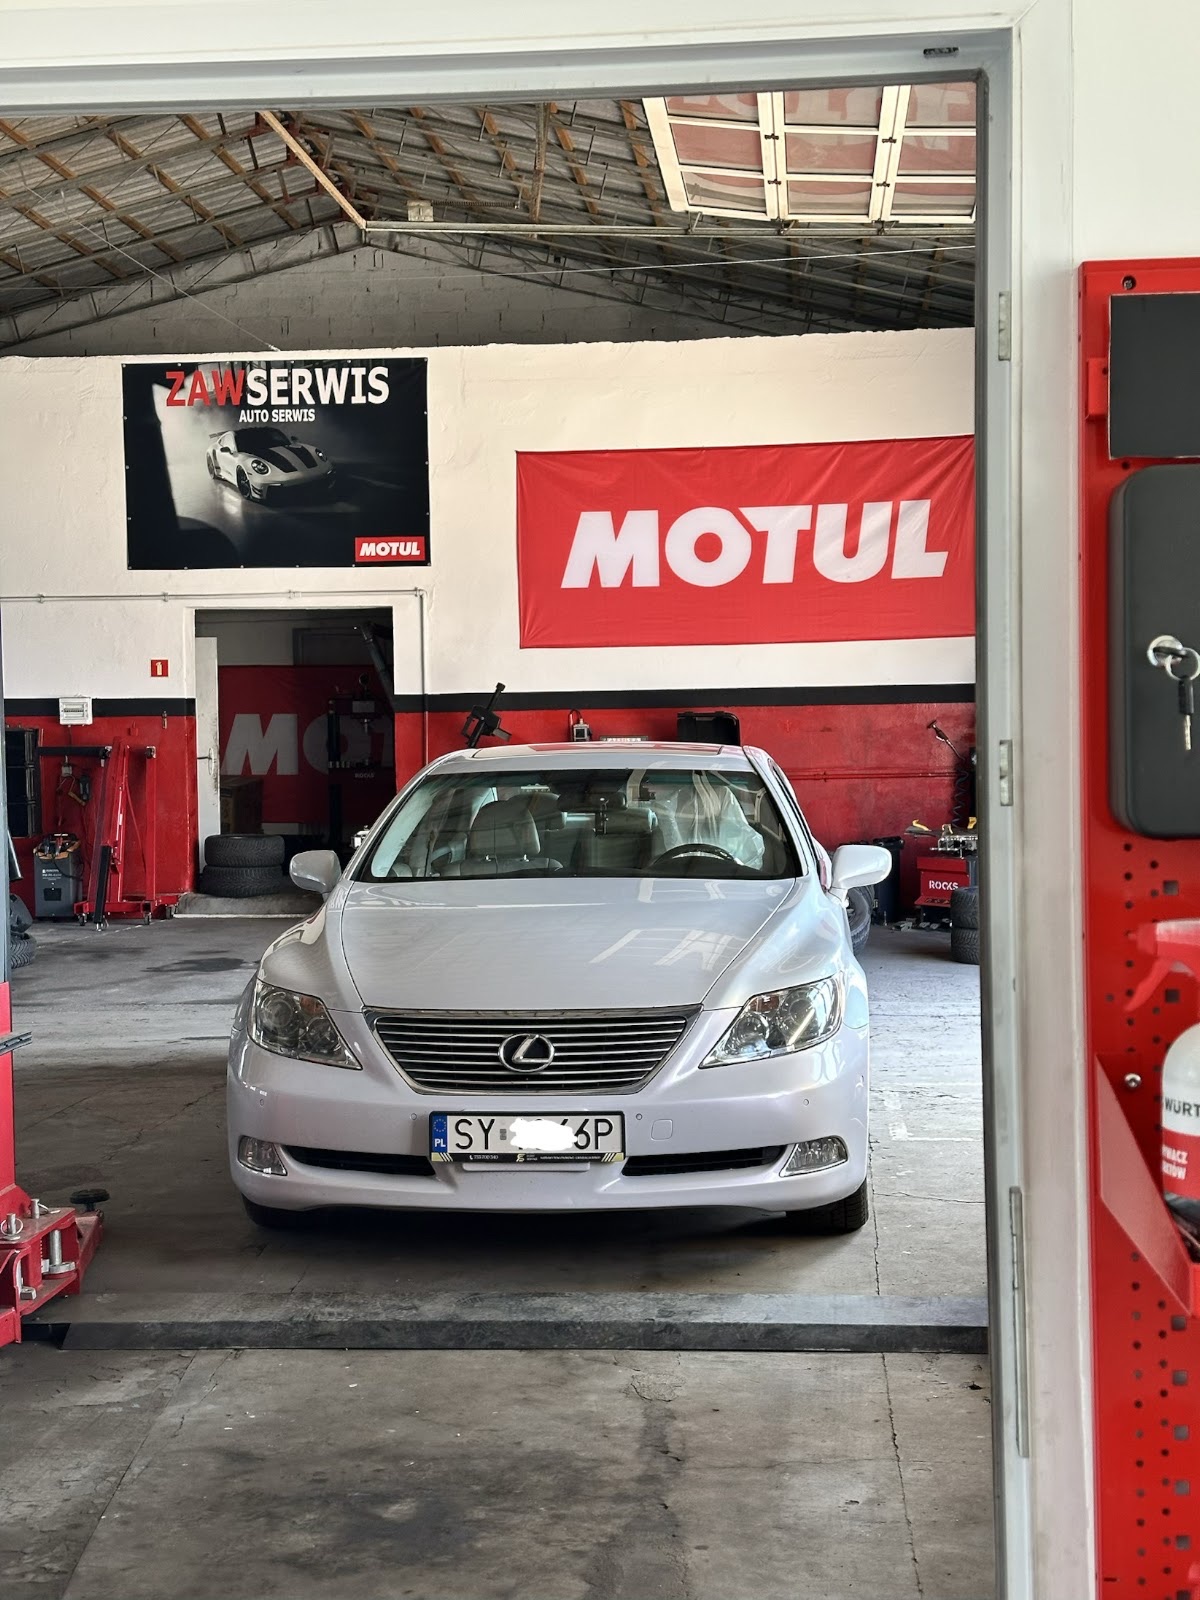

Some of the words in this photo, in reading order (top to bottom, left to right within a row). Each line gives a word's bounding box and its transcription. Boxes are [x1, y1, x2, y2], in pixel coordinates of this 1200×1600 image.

[165, 367, 390, 407] ZAWSERWIS
[239, 409, 269, 423] AUTO
[271, 408, 316, 422] SERWIS
[359, 541, 421, 557] MOTUL
[561, 499, 949, 589] MOTUL
[928, 880, 959, 891] ROCKS
[434, 1138, 446, 1147] PL
